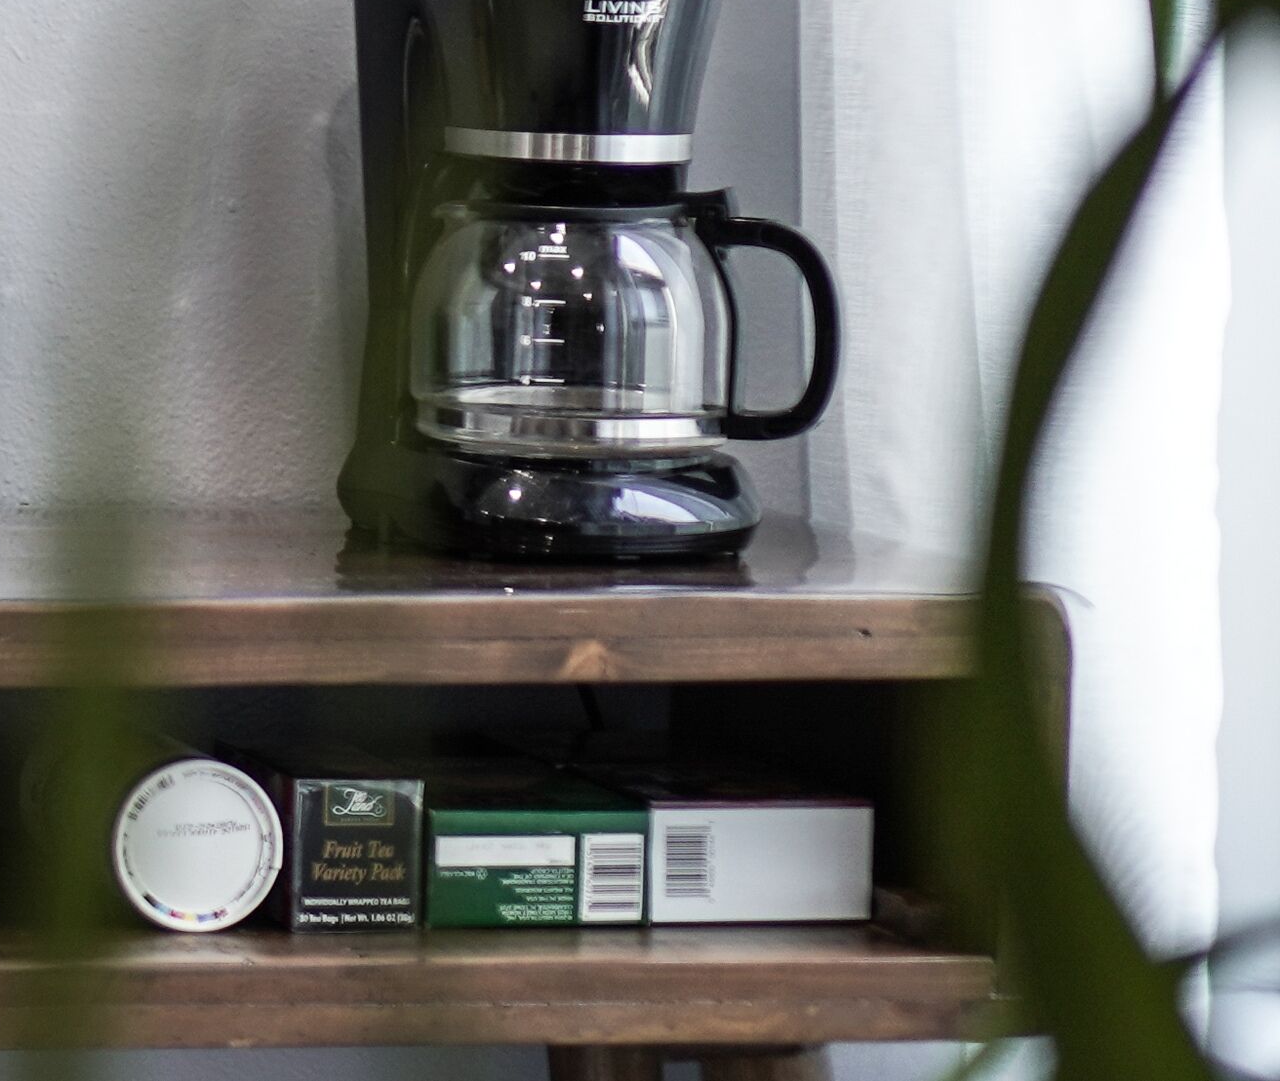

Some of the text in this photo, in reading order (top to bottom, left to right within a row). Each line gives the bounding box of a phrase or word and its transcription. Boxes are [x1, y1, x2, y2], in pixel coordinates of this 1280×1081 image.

[322, 841, 395, 859] Fruit Tea
[312, 863, 406, 885] Variety Pack
